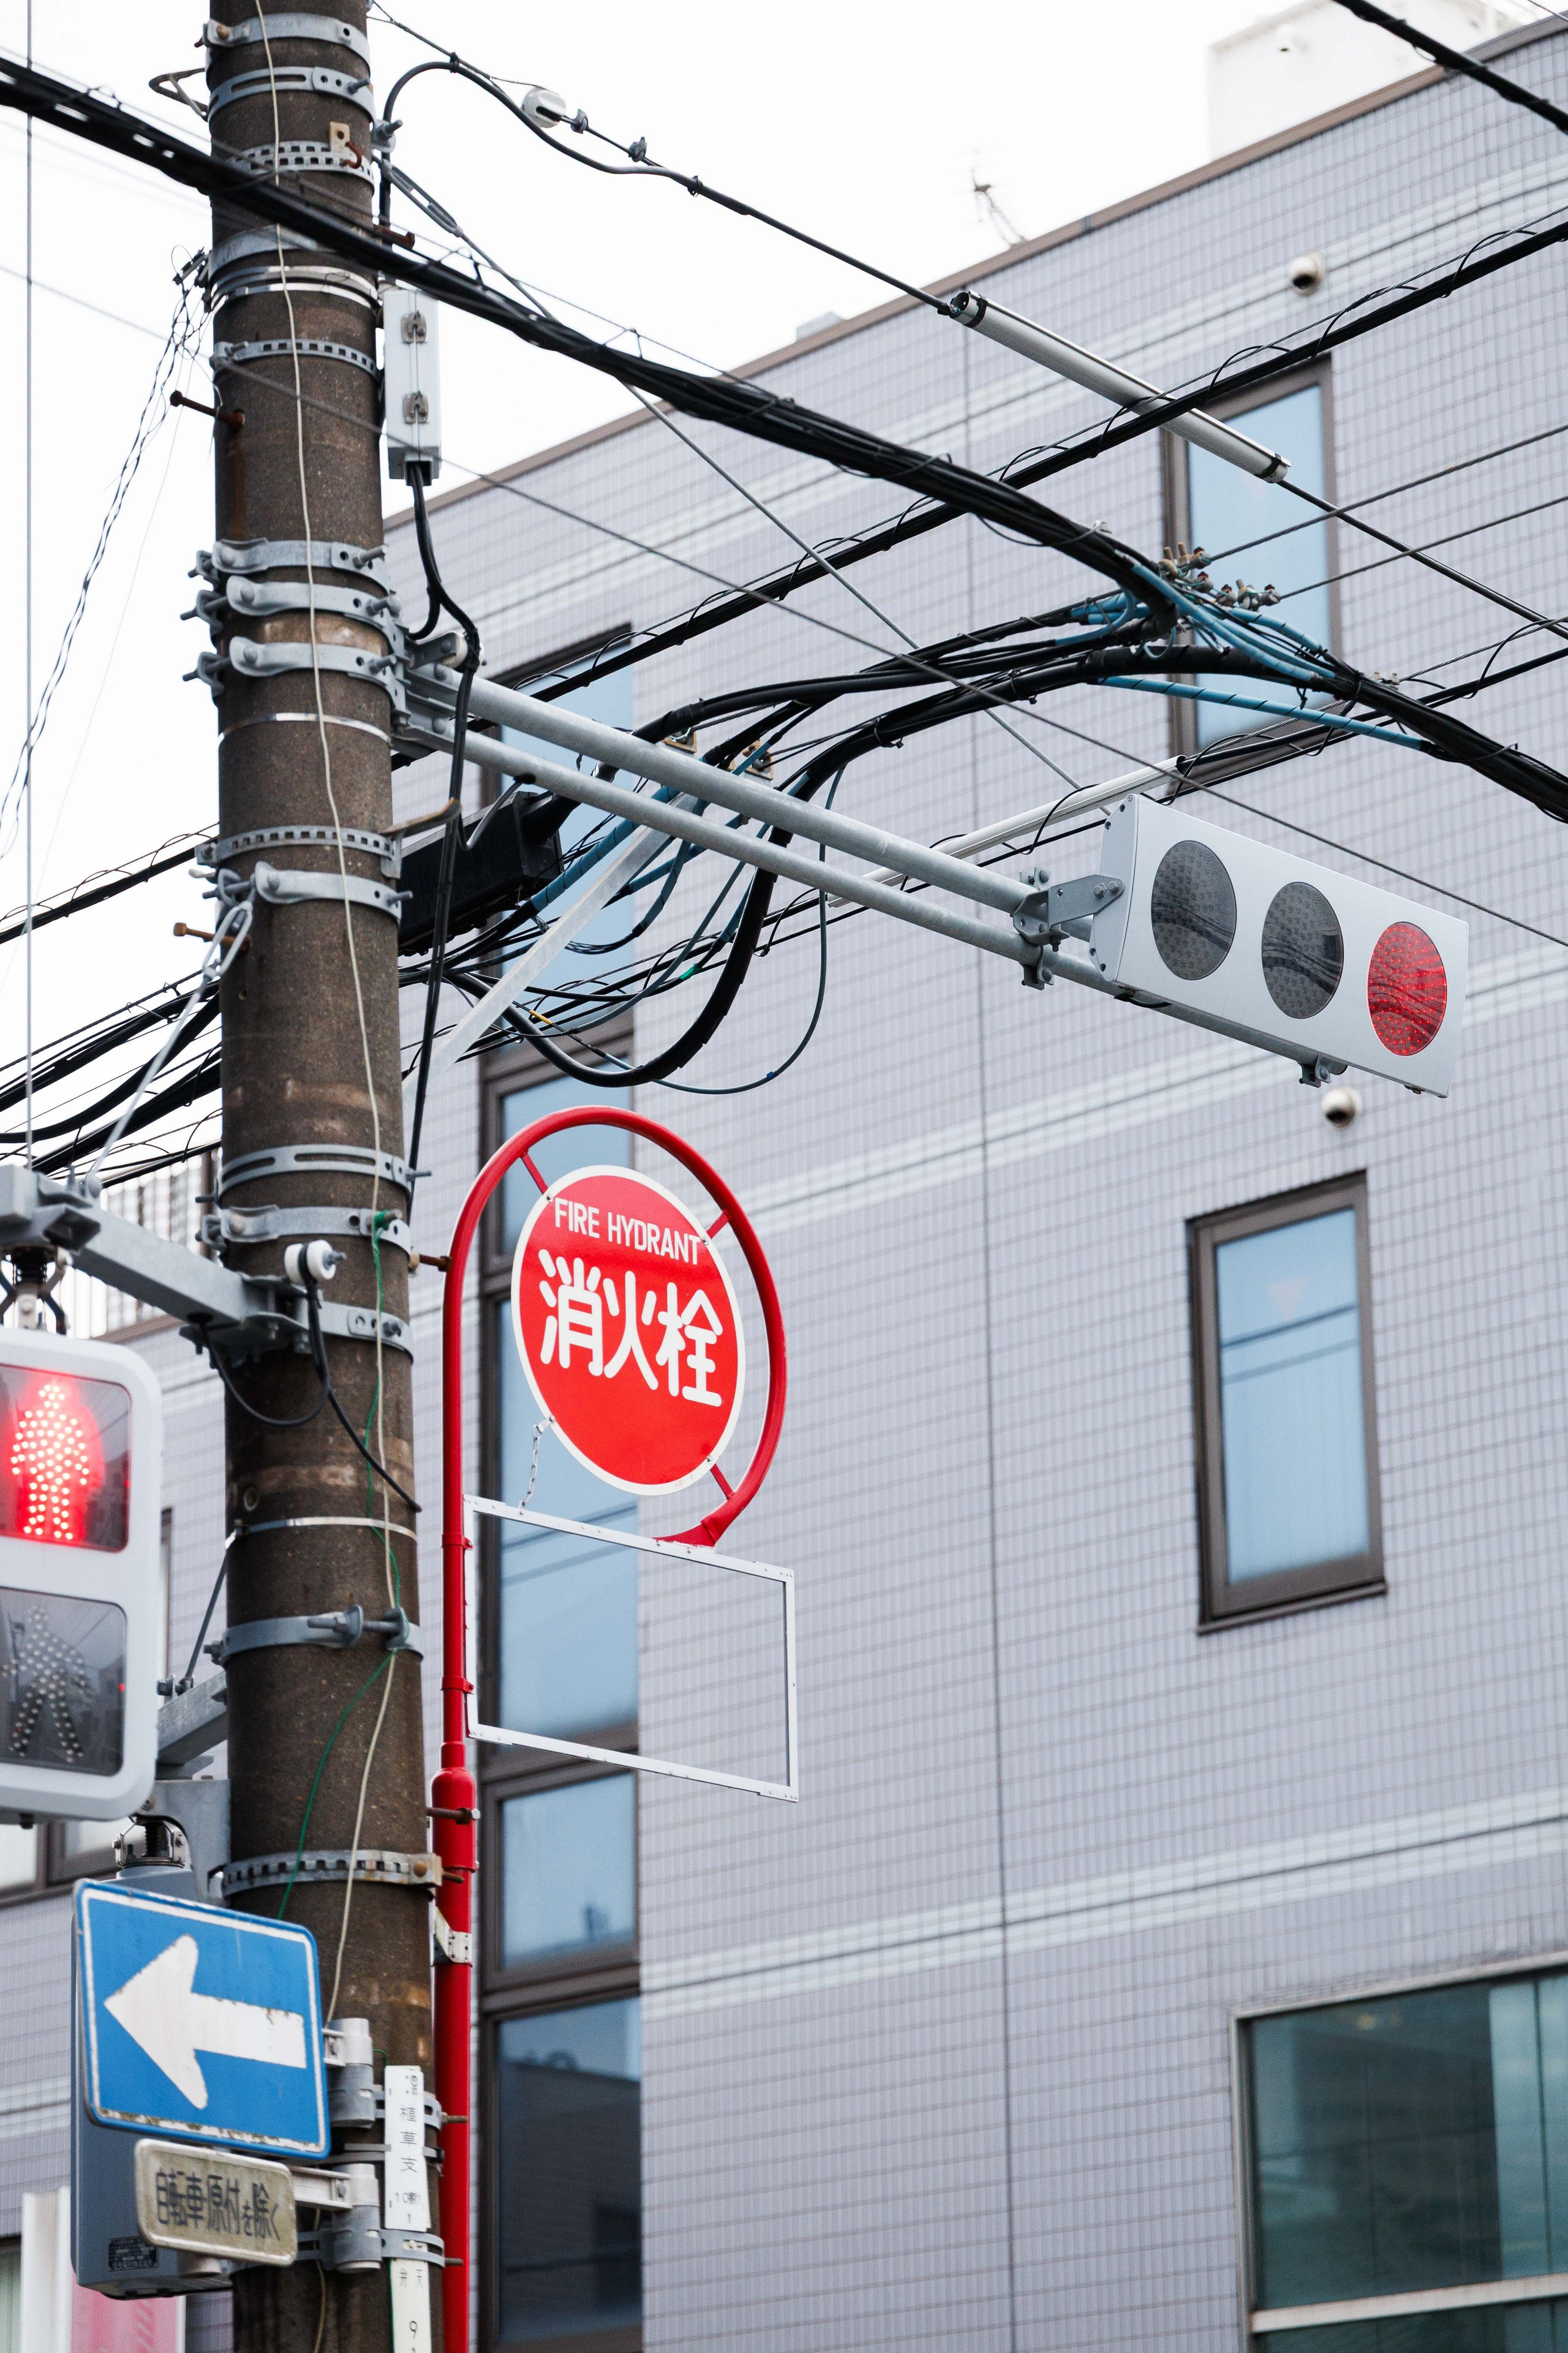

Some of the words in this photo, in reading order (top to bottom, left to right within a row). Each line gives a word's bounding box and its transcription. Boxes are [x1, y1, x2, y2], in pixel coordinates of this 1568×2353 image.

[555, 1198, 600, 1239] FIRE
[608, 1212, 701, 1265] HYDRANT
[538, 1248, 723, 1407] 消火栓
[400, 2105, 418, 2173] 植草支
